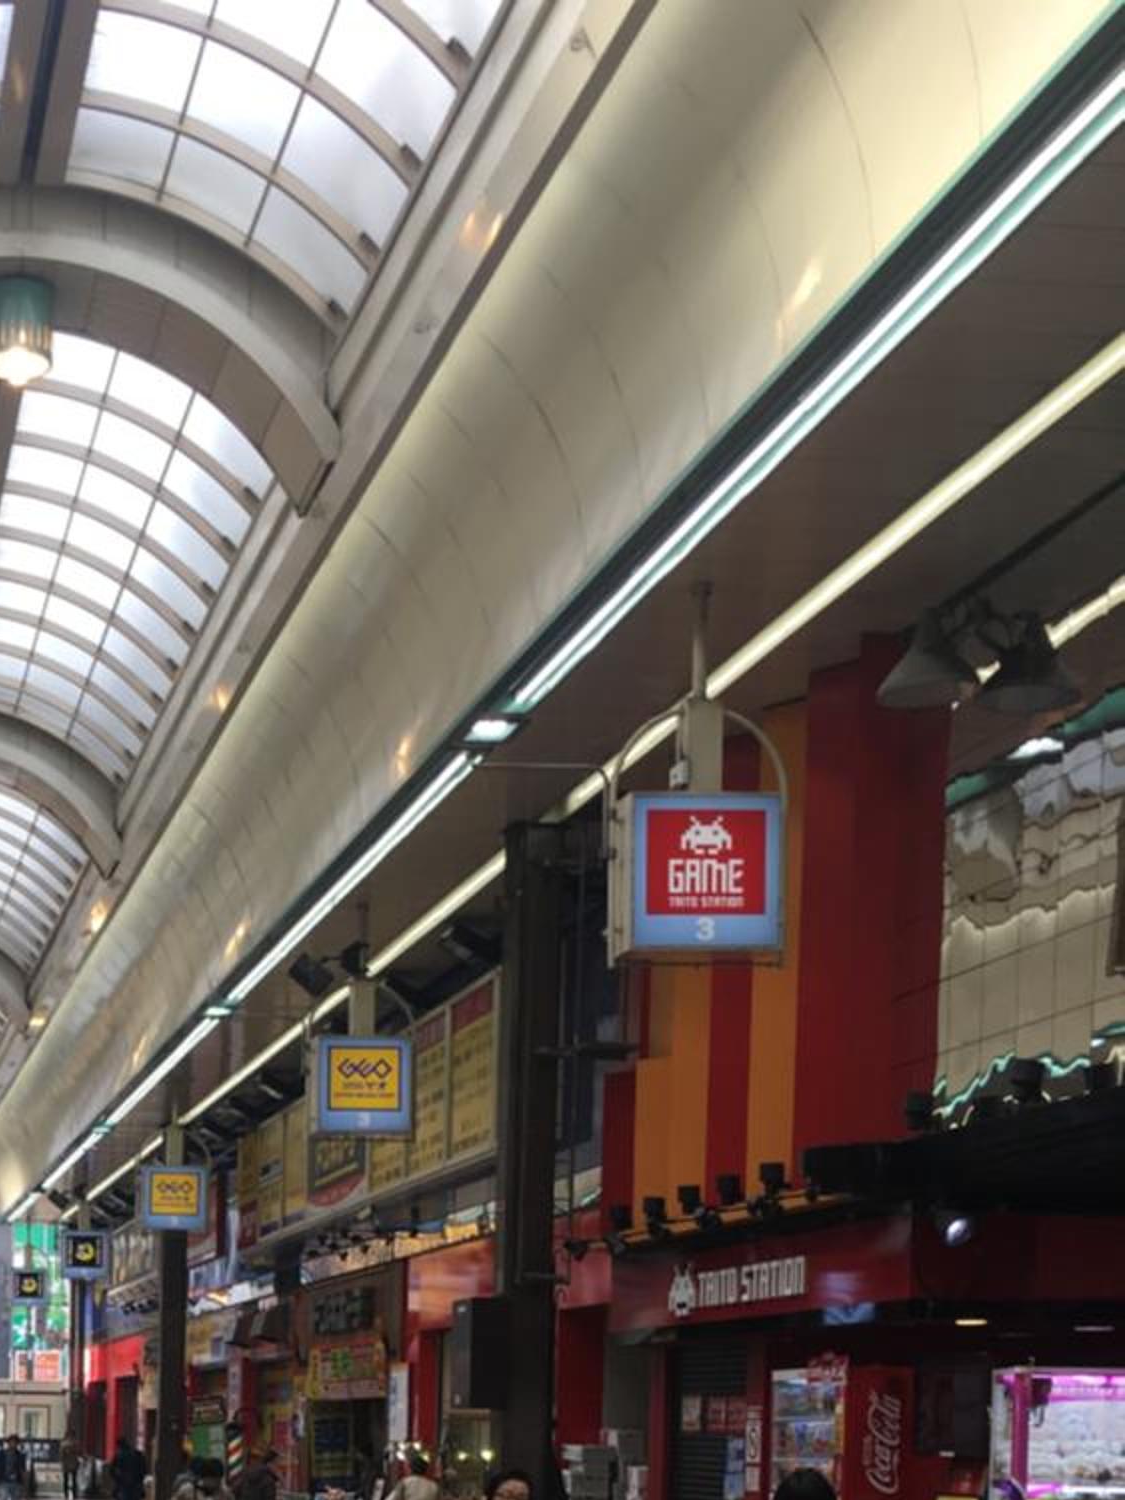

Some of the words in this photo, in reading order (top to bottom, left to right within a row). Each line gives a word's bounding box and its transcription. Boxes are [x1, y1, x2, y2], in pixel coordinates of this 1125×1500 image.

[668, 858, 744, 894] GAME
[698, 917, 714, 940] 3
[337, 1058, 392, 1078] GEO
[740, 1255, 805, 1302] STATION
